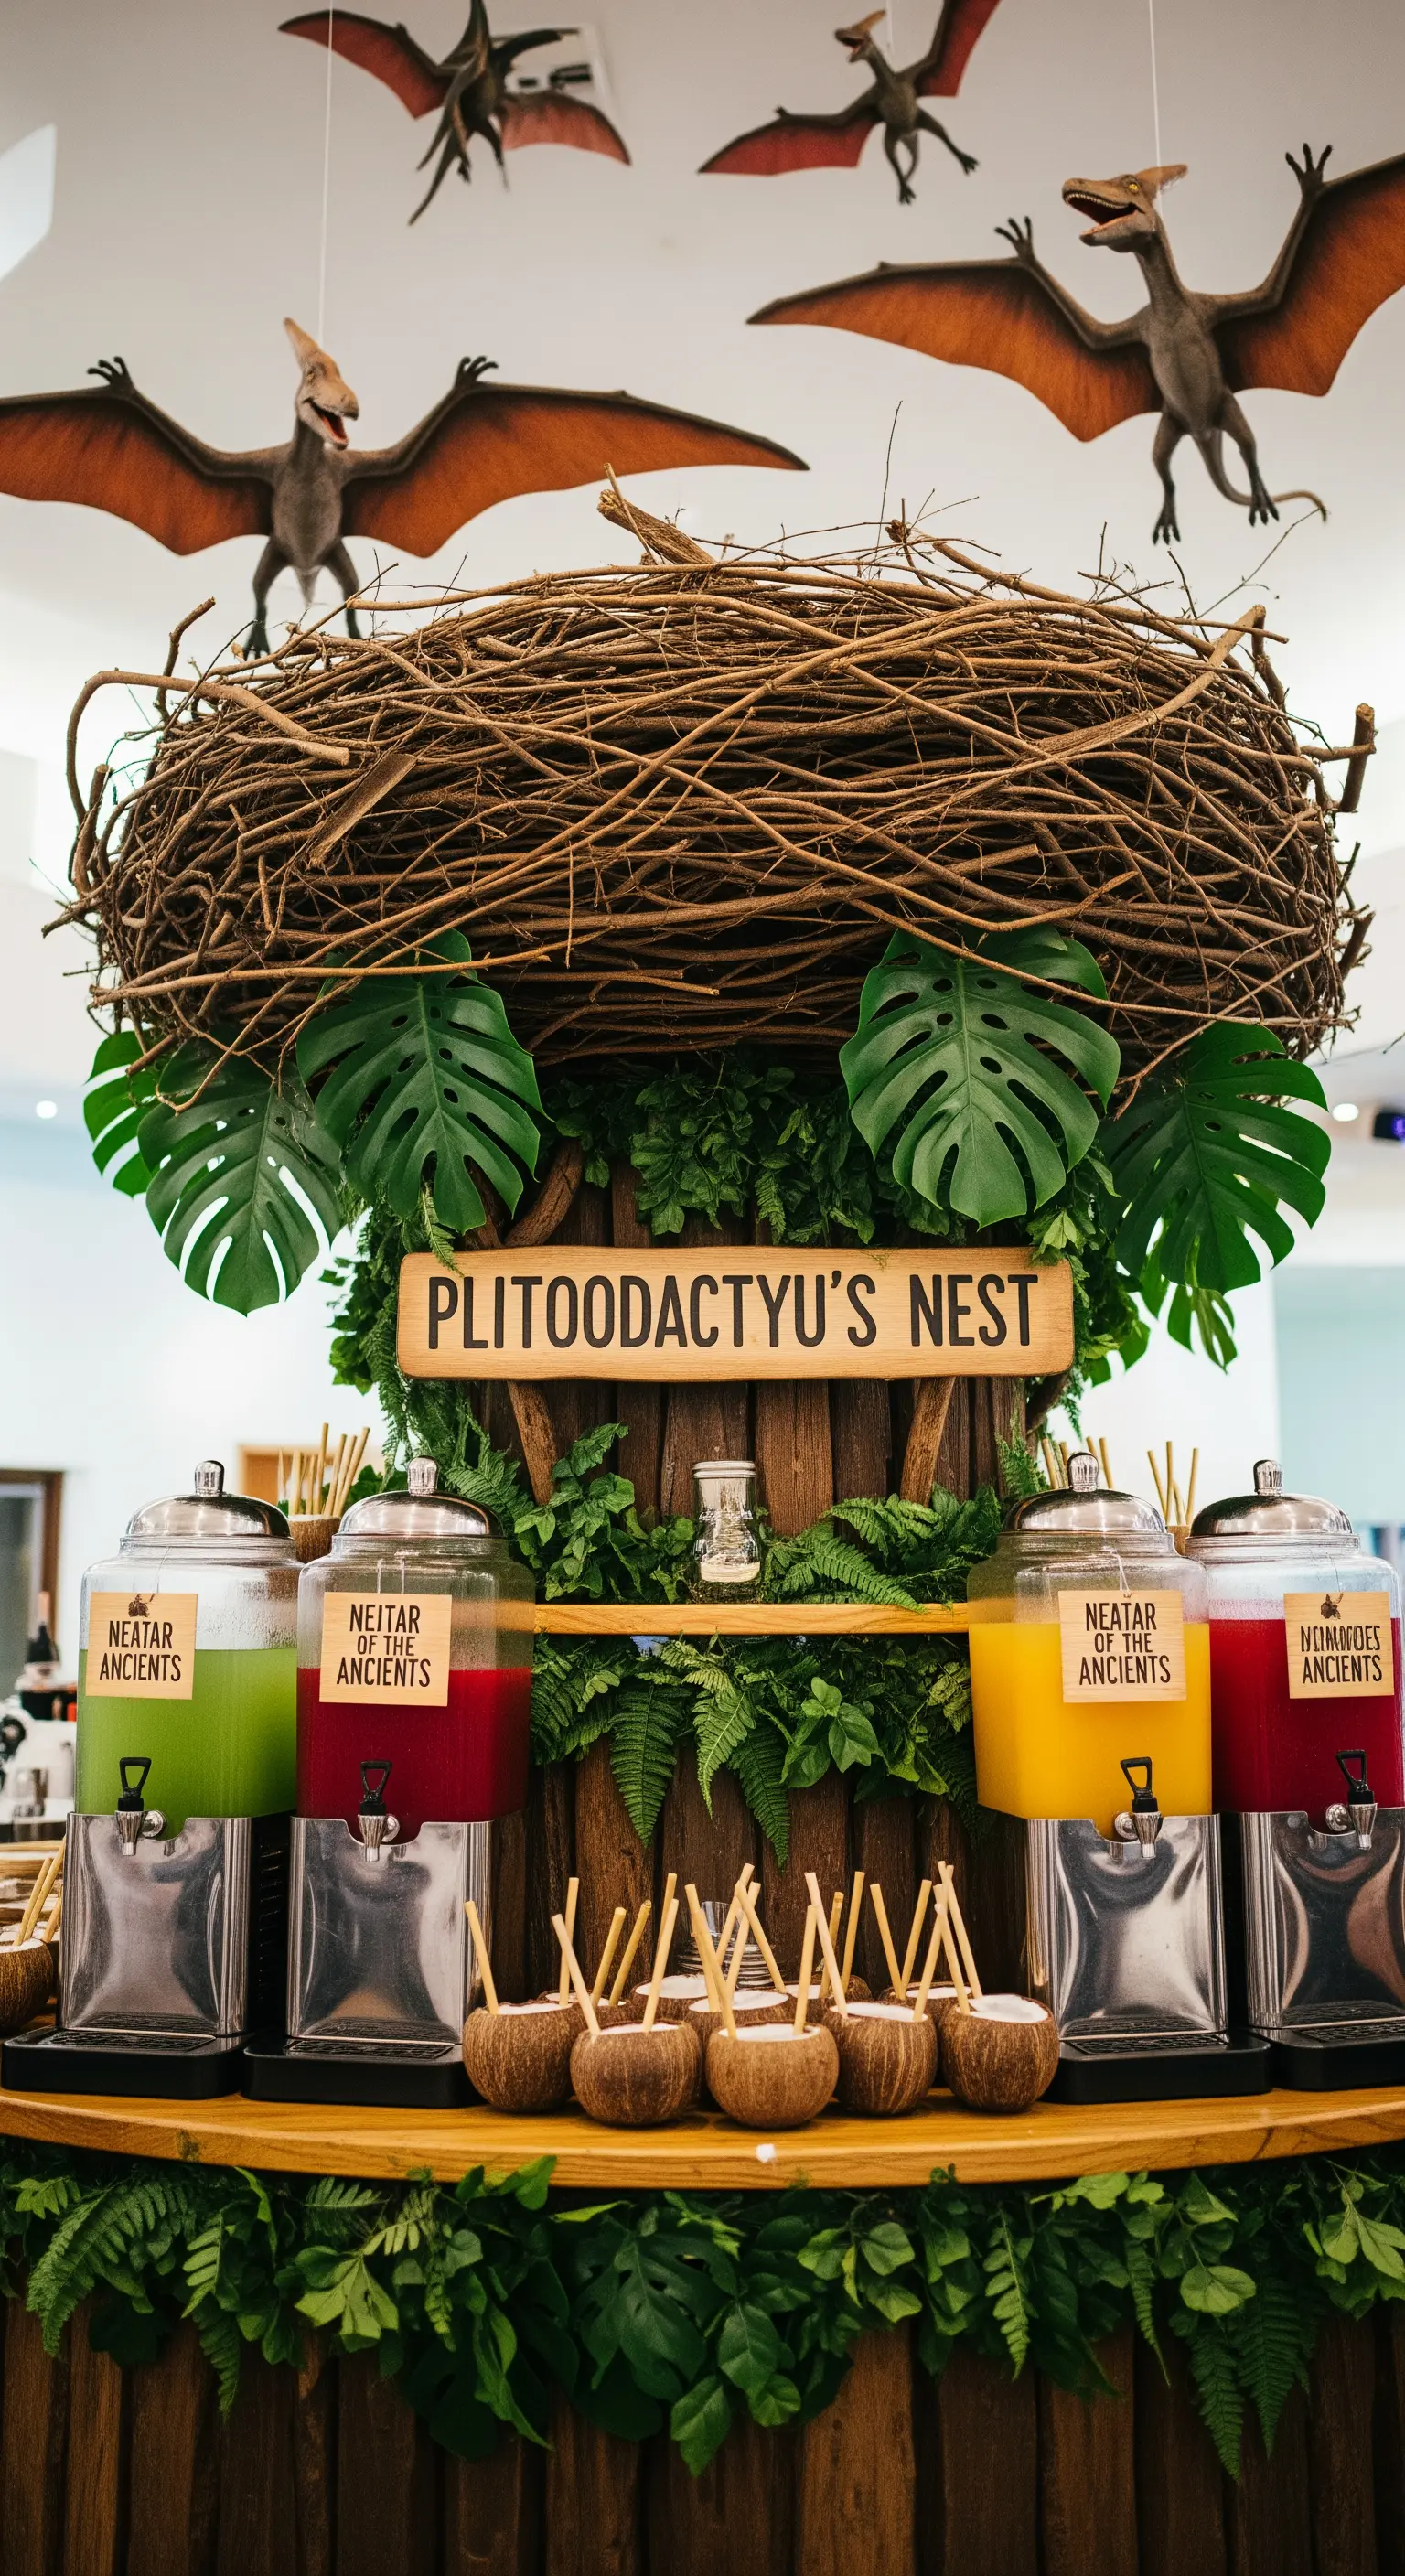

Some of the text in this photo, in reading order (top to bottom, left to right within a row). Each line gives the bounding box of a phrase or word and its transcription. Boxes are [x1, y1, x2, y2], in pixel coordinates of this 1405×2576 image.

[427, 1270, 1039, 1349] PLITOODACTYU'S NEST
[1085, 1603, 1157, 1631] NEATAR
[109, 1620, 173, 1648] NEATAR
[357, 1635, 415, 1656] OF THE
[1094, 1633, 1153, 1653] OF THE
[99, 1652, 181, 1681] ANCIENTS
[336, 1657, 431, 1687] ANCIENTS
[1079, 1655, 1171, 1685] ANCIENTS
[1303, 1654, 1382, 1684] ANCIENTS
